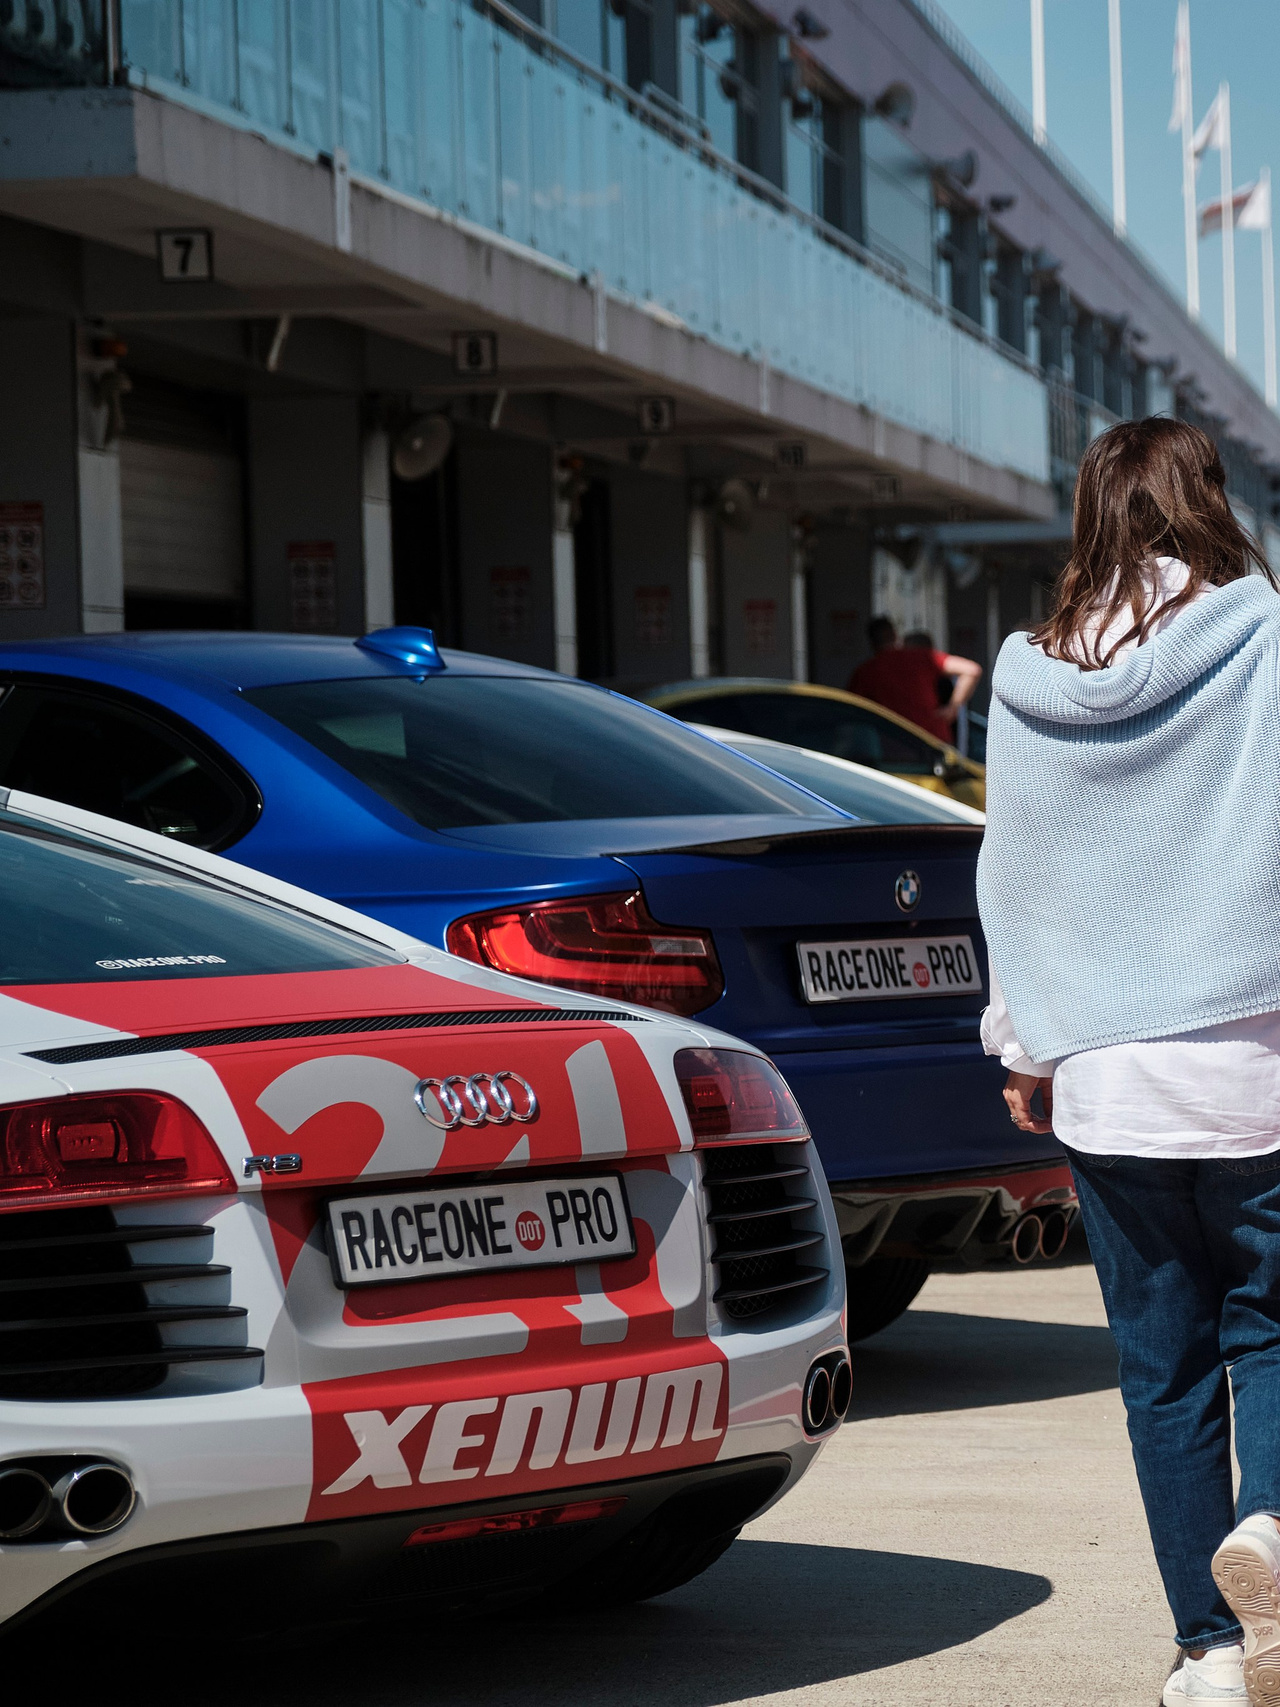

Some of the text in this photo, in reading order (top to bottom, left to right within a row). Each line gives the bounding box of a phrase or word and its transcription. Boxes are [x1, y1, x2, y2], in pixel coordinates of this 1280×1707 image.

[173, 237, 194, 275] 7
[807, 944, 972, 992] RACEONE DOT PRO
[242, 1154, 300, 1177] R8
[341, 1187, 618, 1270] RACEONE DOT PRO
